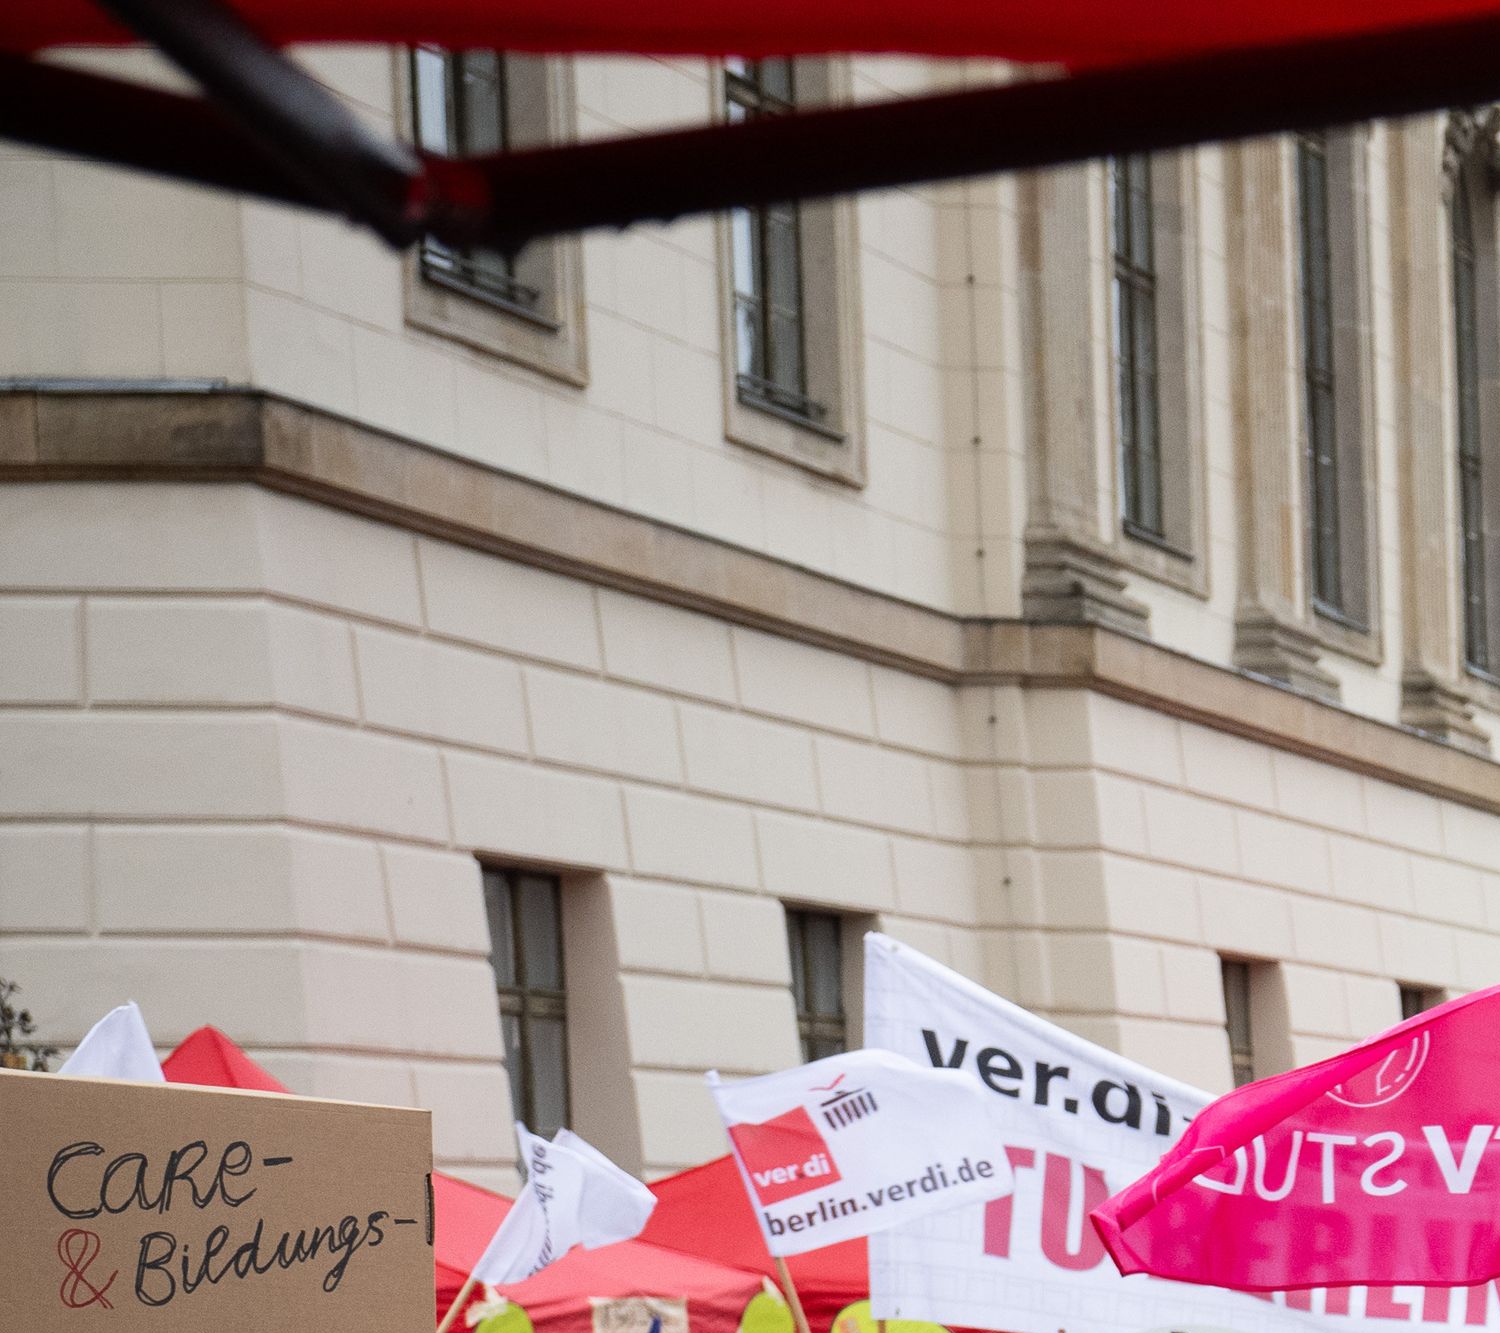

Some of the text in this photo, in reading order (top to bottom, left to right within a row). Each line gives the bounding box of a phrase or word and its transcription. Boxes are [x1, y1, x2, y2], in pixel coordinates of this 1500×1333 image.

[753, 1153, 831, 1188] ver.di
[764, 1157, 995, 1238] berlin.verdi.de
[57, 1211, 418, 1309] & Bildungs-
